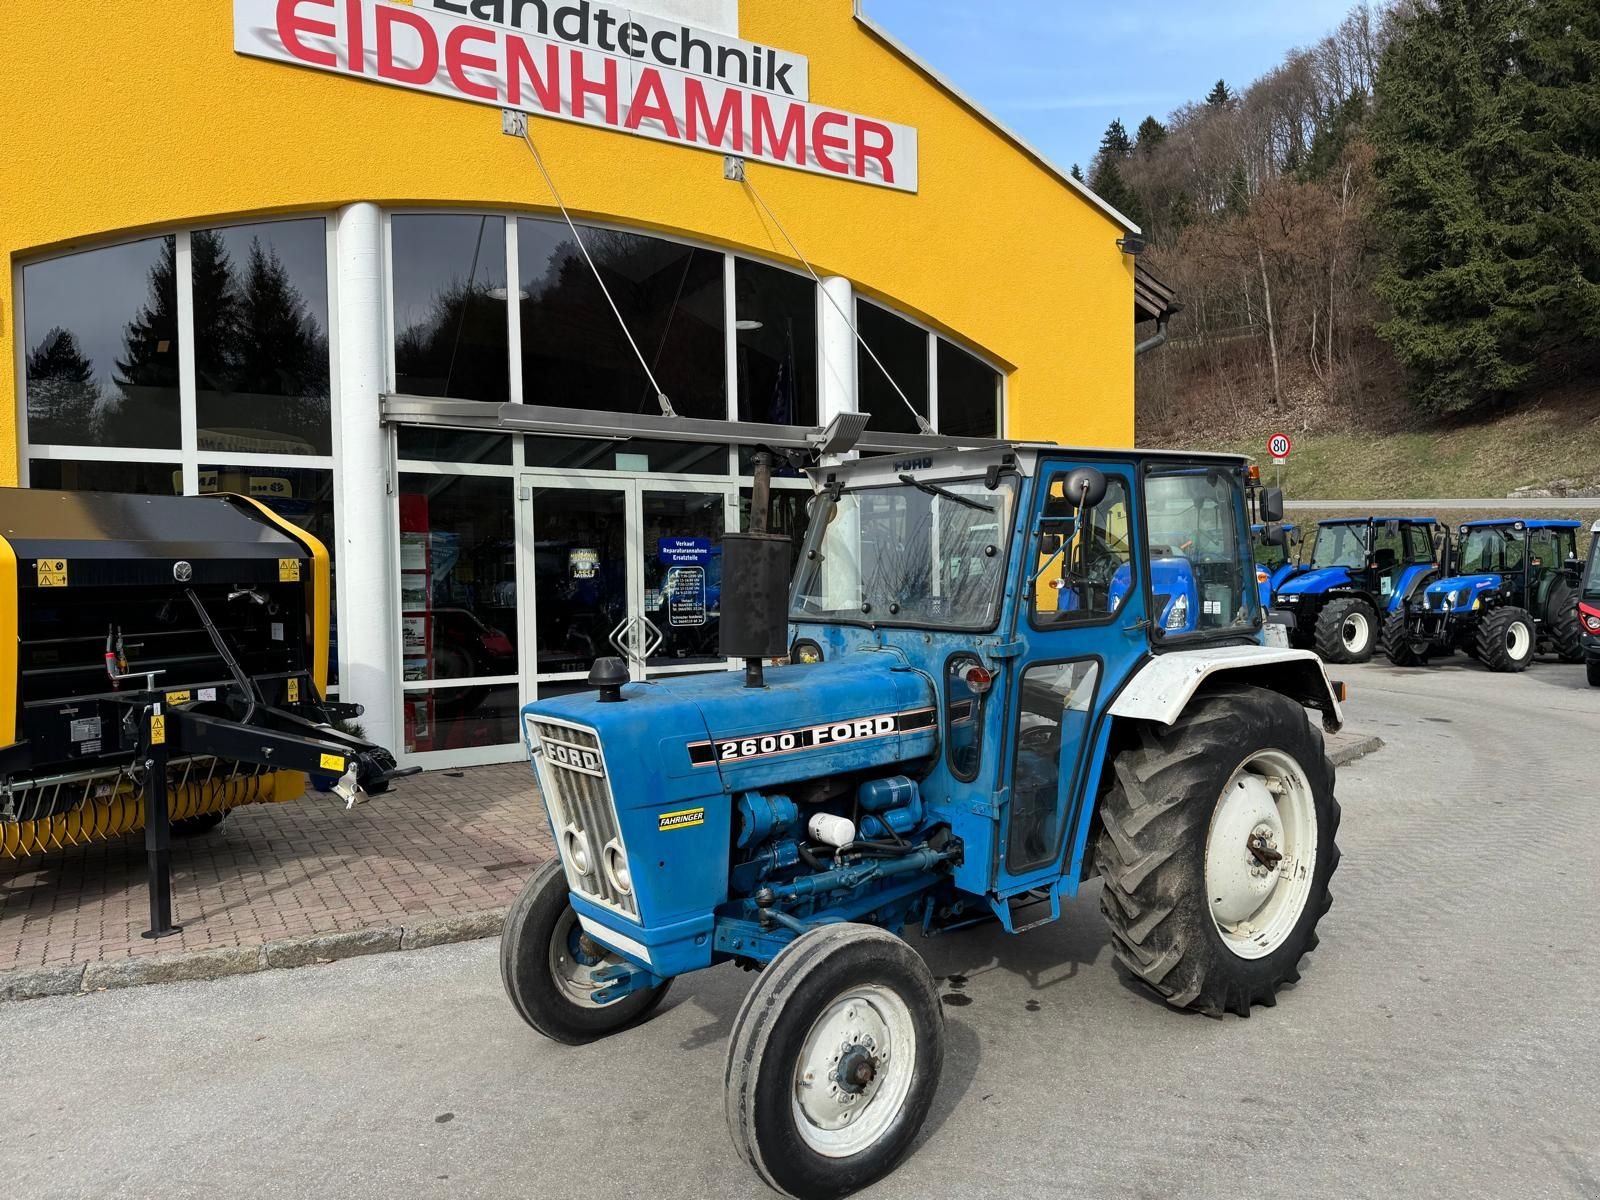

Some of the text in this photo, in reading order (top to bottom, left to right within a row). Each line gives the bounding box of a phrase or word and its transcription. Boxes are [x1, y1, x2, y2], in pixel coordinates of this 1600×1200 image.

[276, 0, 895, 184] EIDENHAMMER
[1273, 439, 1287, 452] 80
[722, 717, 896, 760] 2600 FORD
[546, 743, 596, 770] FORD
[660, 812, 704, 826] FAHRINGER
